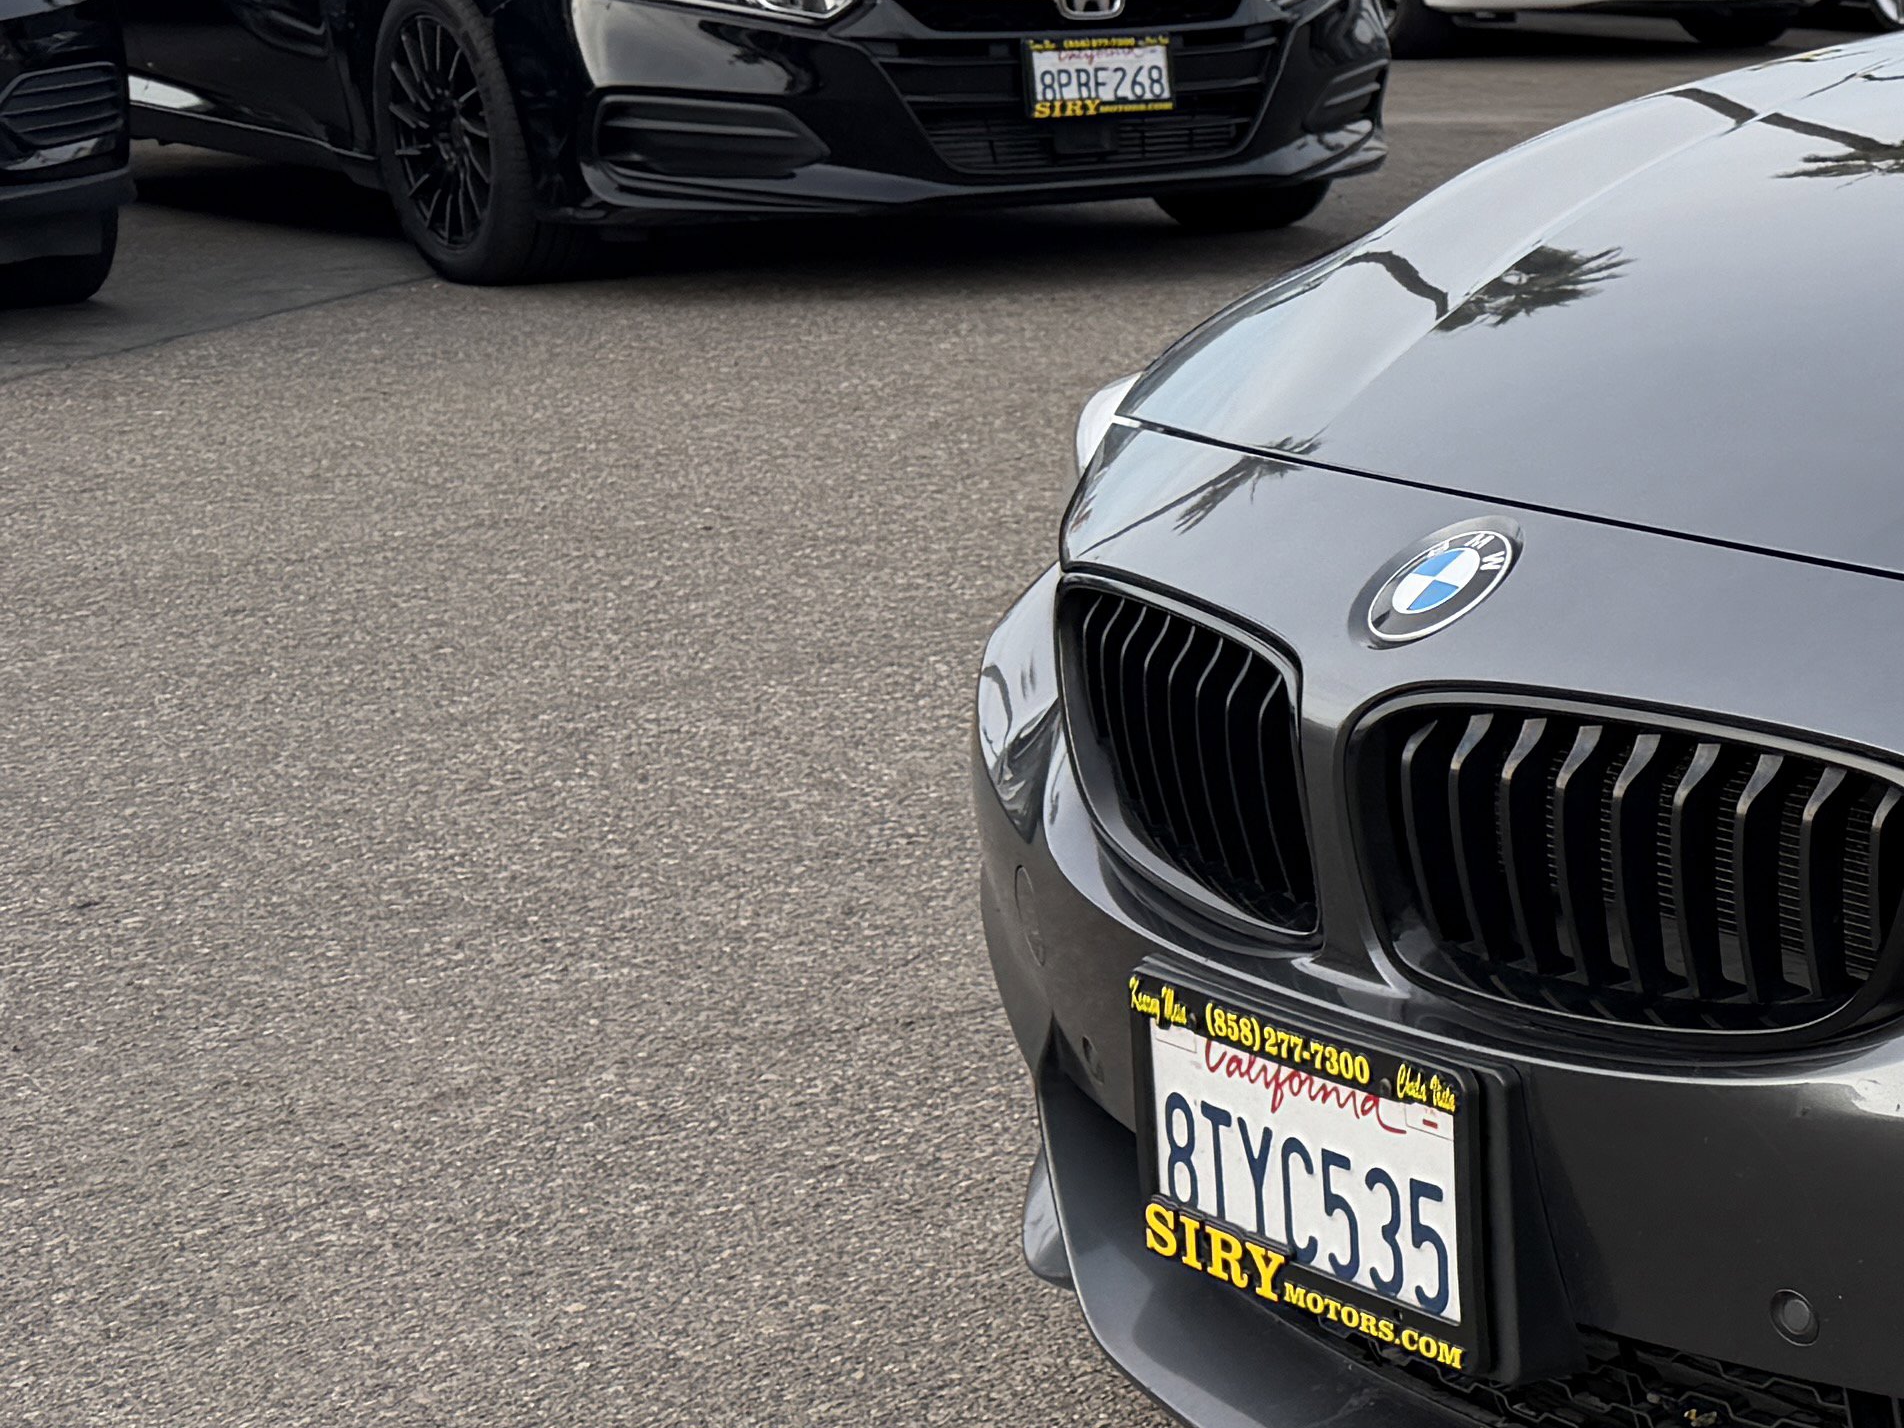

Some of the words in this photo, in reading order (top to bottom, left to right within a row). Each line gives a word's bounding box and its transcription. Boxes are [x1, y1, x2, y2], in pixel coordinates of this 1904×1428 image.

[1033, 99, 1101, 118] SIRY
[1203, 1040, 1407, 1134] California
[1205, 1003, 1260, 1051] (858)
[1264, 1027, 1370, 1085] 277-7300
[1165, 1090, 1450, 1317] 8TYC535
[1144, 1202, 1287, 1302] SIRY
[1282, 1282, 1464, 1370] MOTORS.COM
